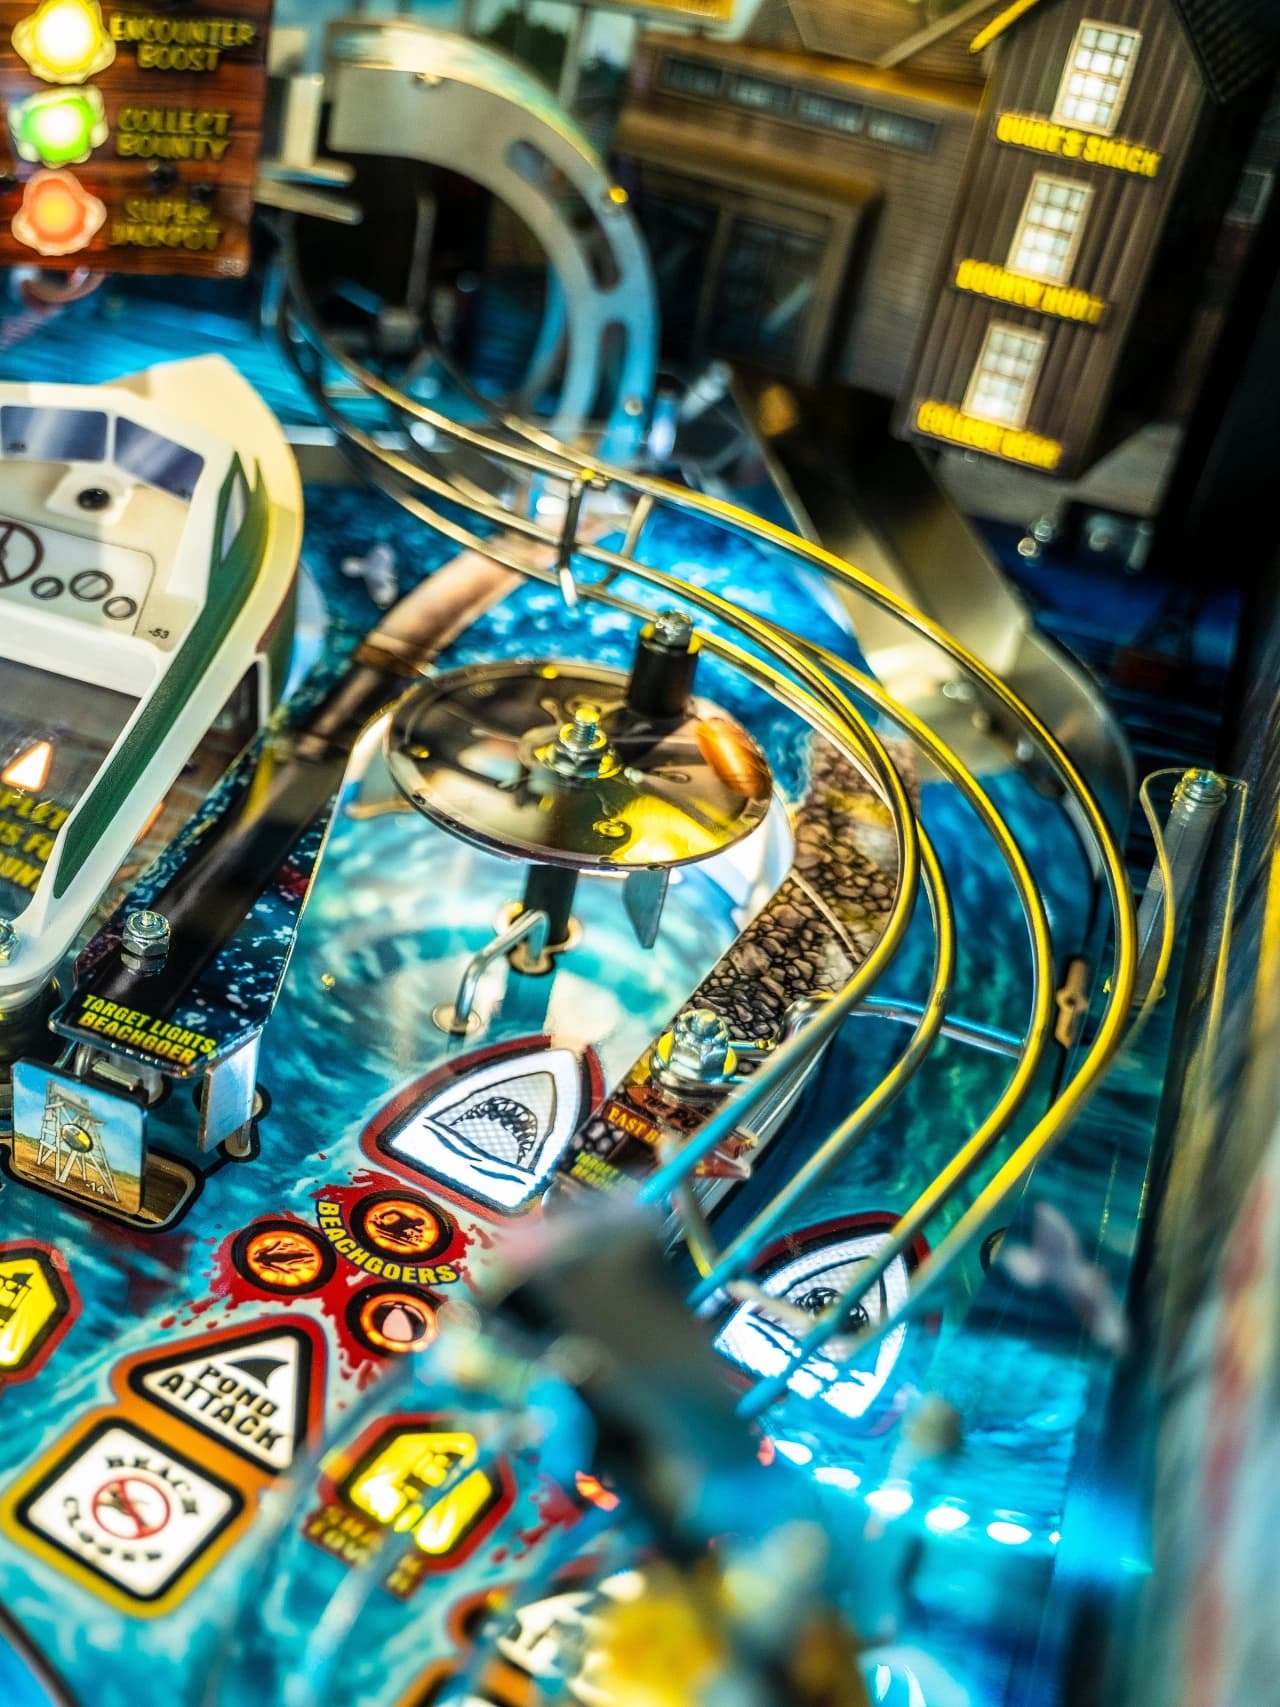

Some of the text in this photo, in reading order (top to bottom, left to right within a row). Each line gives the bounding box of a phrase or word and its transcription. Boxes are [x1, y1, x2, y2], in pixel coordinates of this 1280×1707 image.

[110, 16, 255, 46] ENCOUNTER
[138, 44, 219, 70] BOOST
[118, 109, 230, 135] COLLECT
[117, 133, 230, 159] BOUNTY
[125, 199, 211, 225] SUPER
[78, 1010, 197, 1064] BEACHGOER
[82, 994, 217, 1053] TARGET LIGHTS
[608, 1107, 648, 1138] EAST
[318, 1201, 458, 1284] BEACHGOERS
[198, 1364, 279, 1417] POND
[158, 1373, 285, 1451] ATTACK
